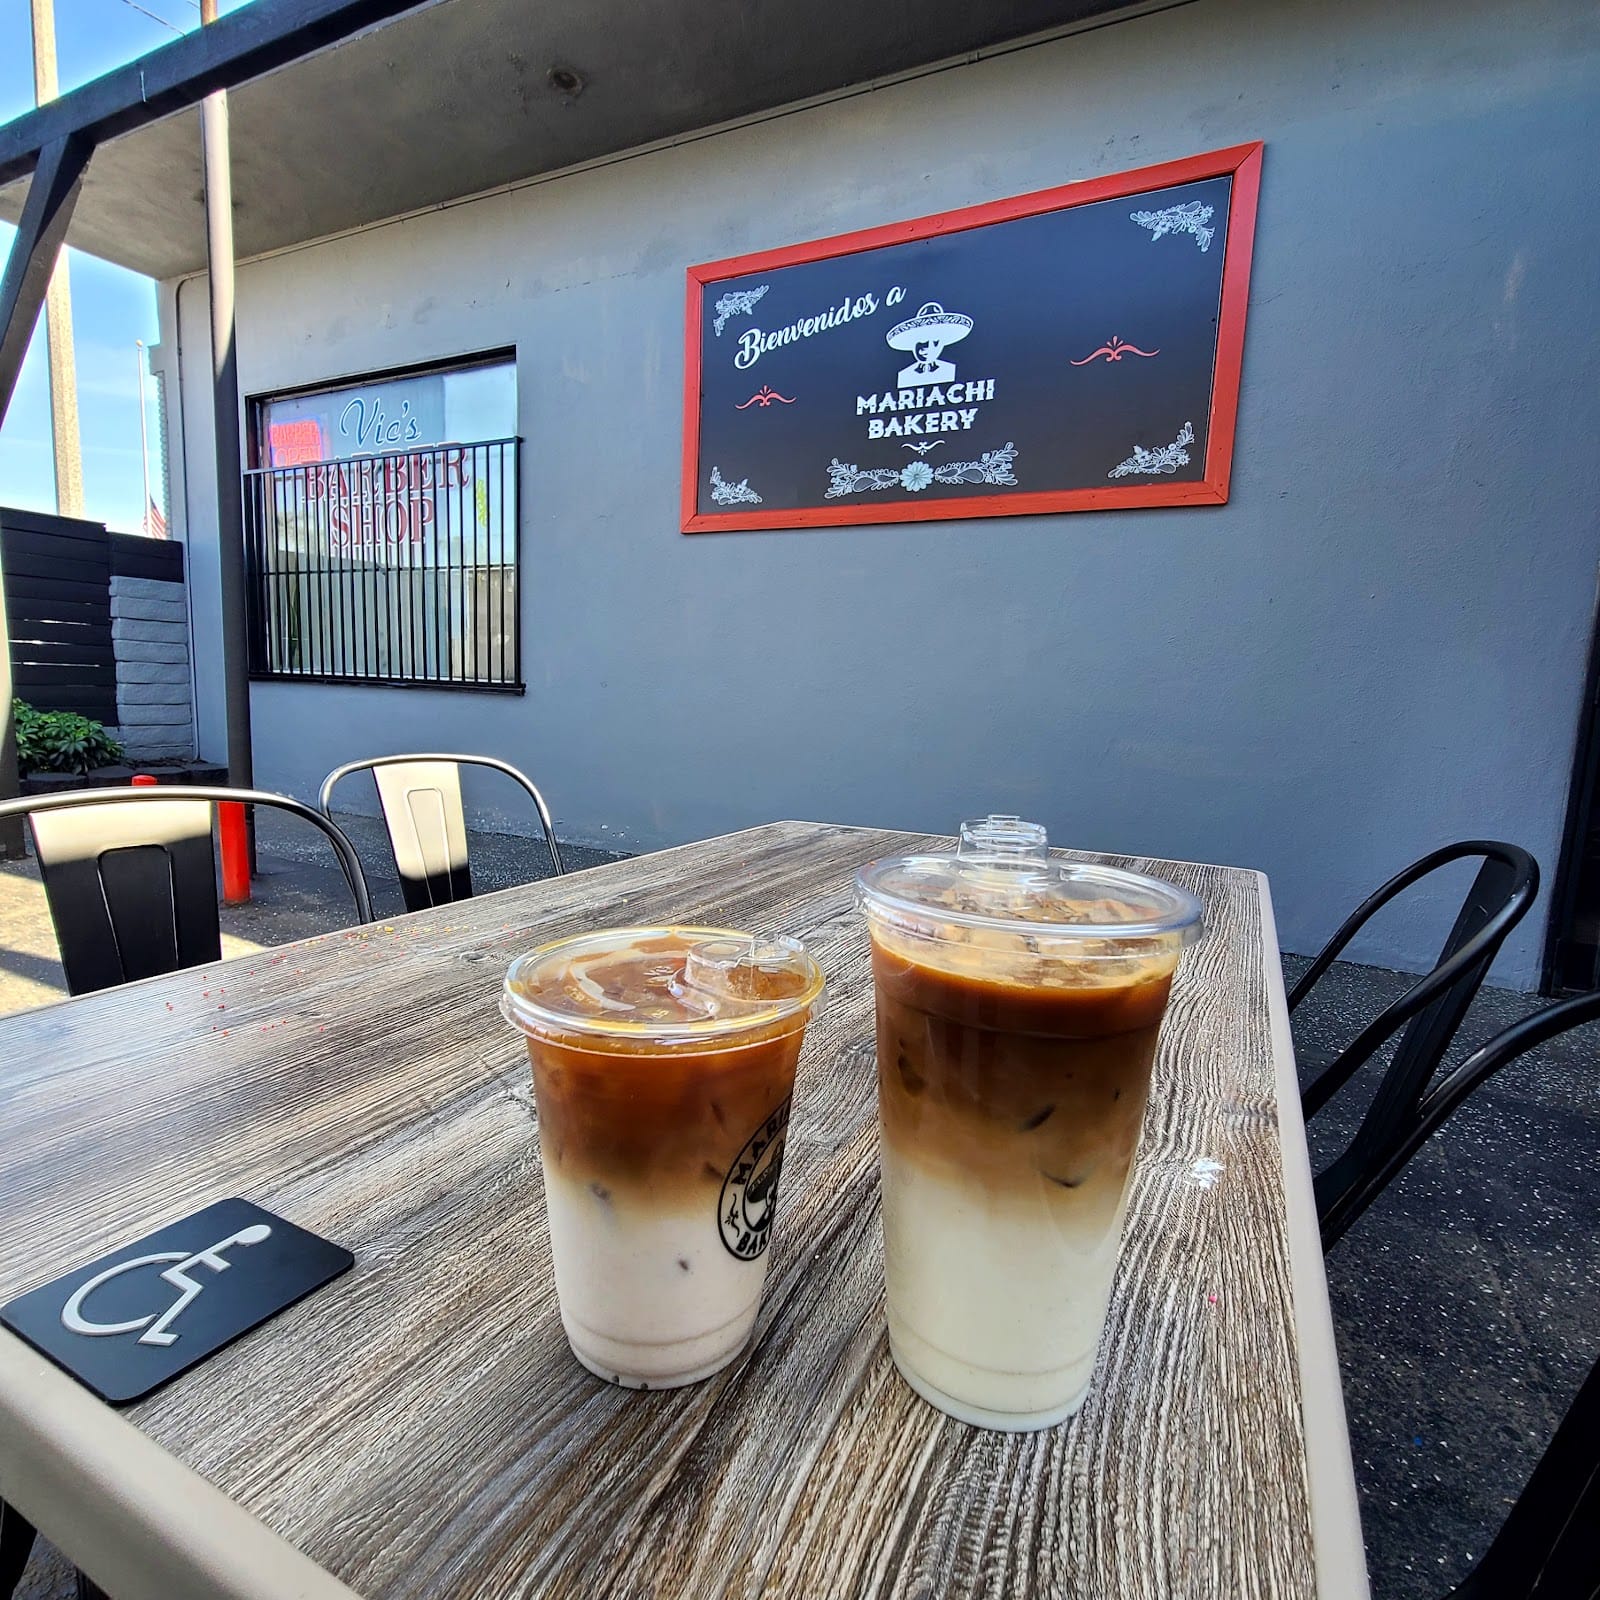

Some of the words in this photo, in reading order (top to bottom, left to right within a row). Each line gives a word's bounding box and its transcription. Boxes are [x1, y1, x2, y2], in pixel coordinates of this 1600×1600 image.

[734, 291, 879, 370] Bienvenidos
[885, 286, 907, 307] a
[339, 397, 422, 448] Vic's
[856, 379, 995, 416] MARIACHI
[868, 408, 978, 439] BAKERY
[301, 442, 471, 502] BARBER
[330, 496, 435, 548] SHOP
